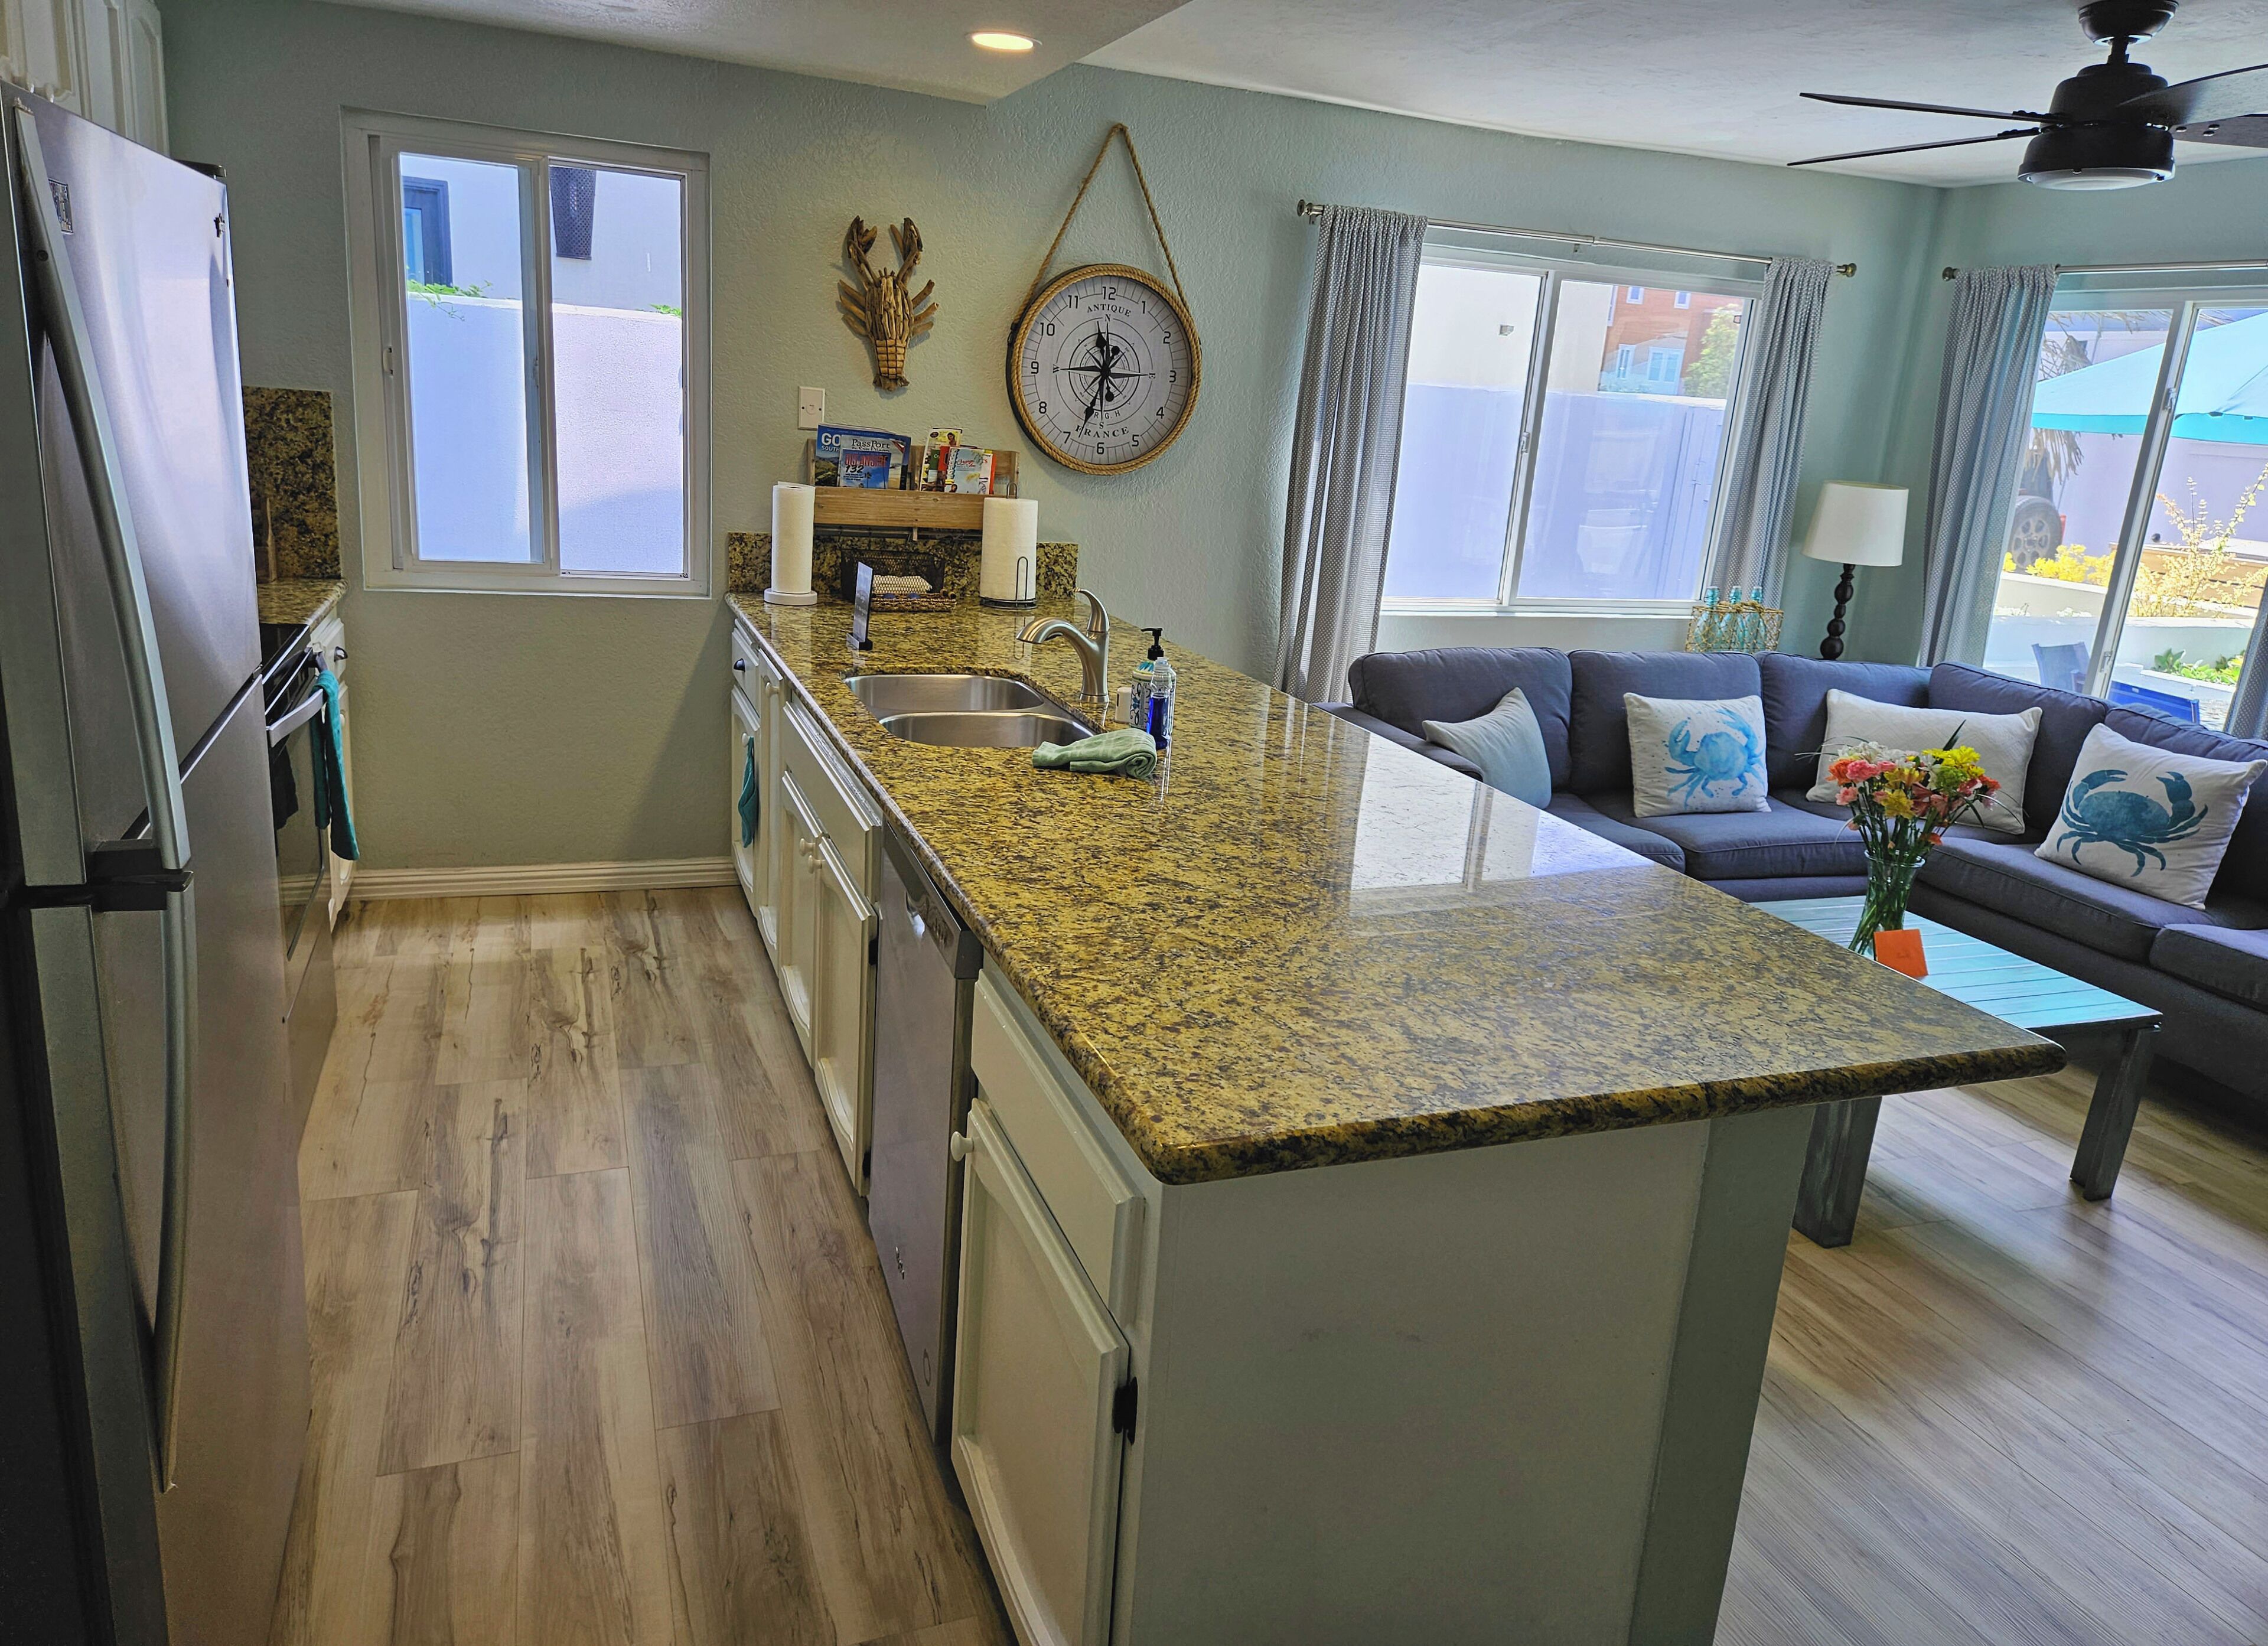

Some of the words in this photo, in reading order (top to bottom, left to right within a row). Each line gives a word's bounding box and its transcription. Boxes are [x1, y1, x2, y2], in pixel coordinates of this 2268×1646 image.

[1102, 286, 1116, 300] 12
[1068, 295, 1079, 309] 11
[1141, 301, 1146, 314] 1
[1087, 304, 1131, 317] ANTIQUE
[1040, 322, 1055, 336] 10
[1163, 331, 1171, 344] 2
[1031, 361, 1039, 374] 9
[1169, 370, 1177, 383] 3
[1038, 401, 1047, 414] 8
[1156, 407, 1165, 419] 4
[1075, 425, 1129, 438] FRANCE
[1099, 421, 1104, 429] S
[821, 432, 841, 446] GO
[851, 439, 890, 449] PassPort
[1063, 432, 1071, 444] 7
[1132, 435, 1139, 446] 5
[1097, 442, 1104, 455] 6
[845, 465, 864, 473] 132
